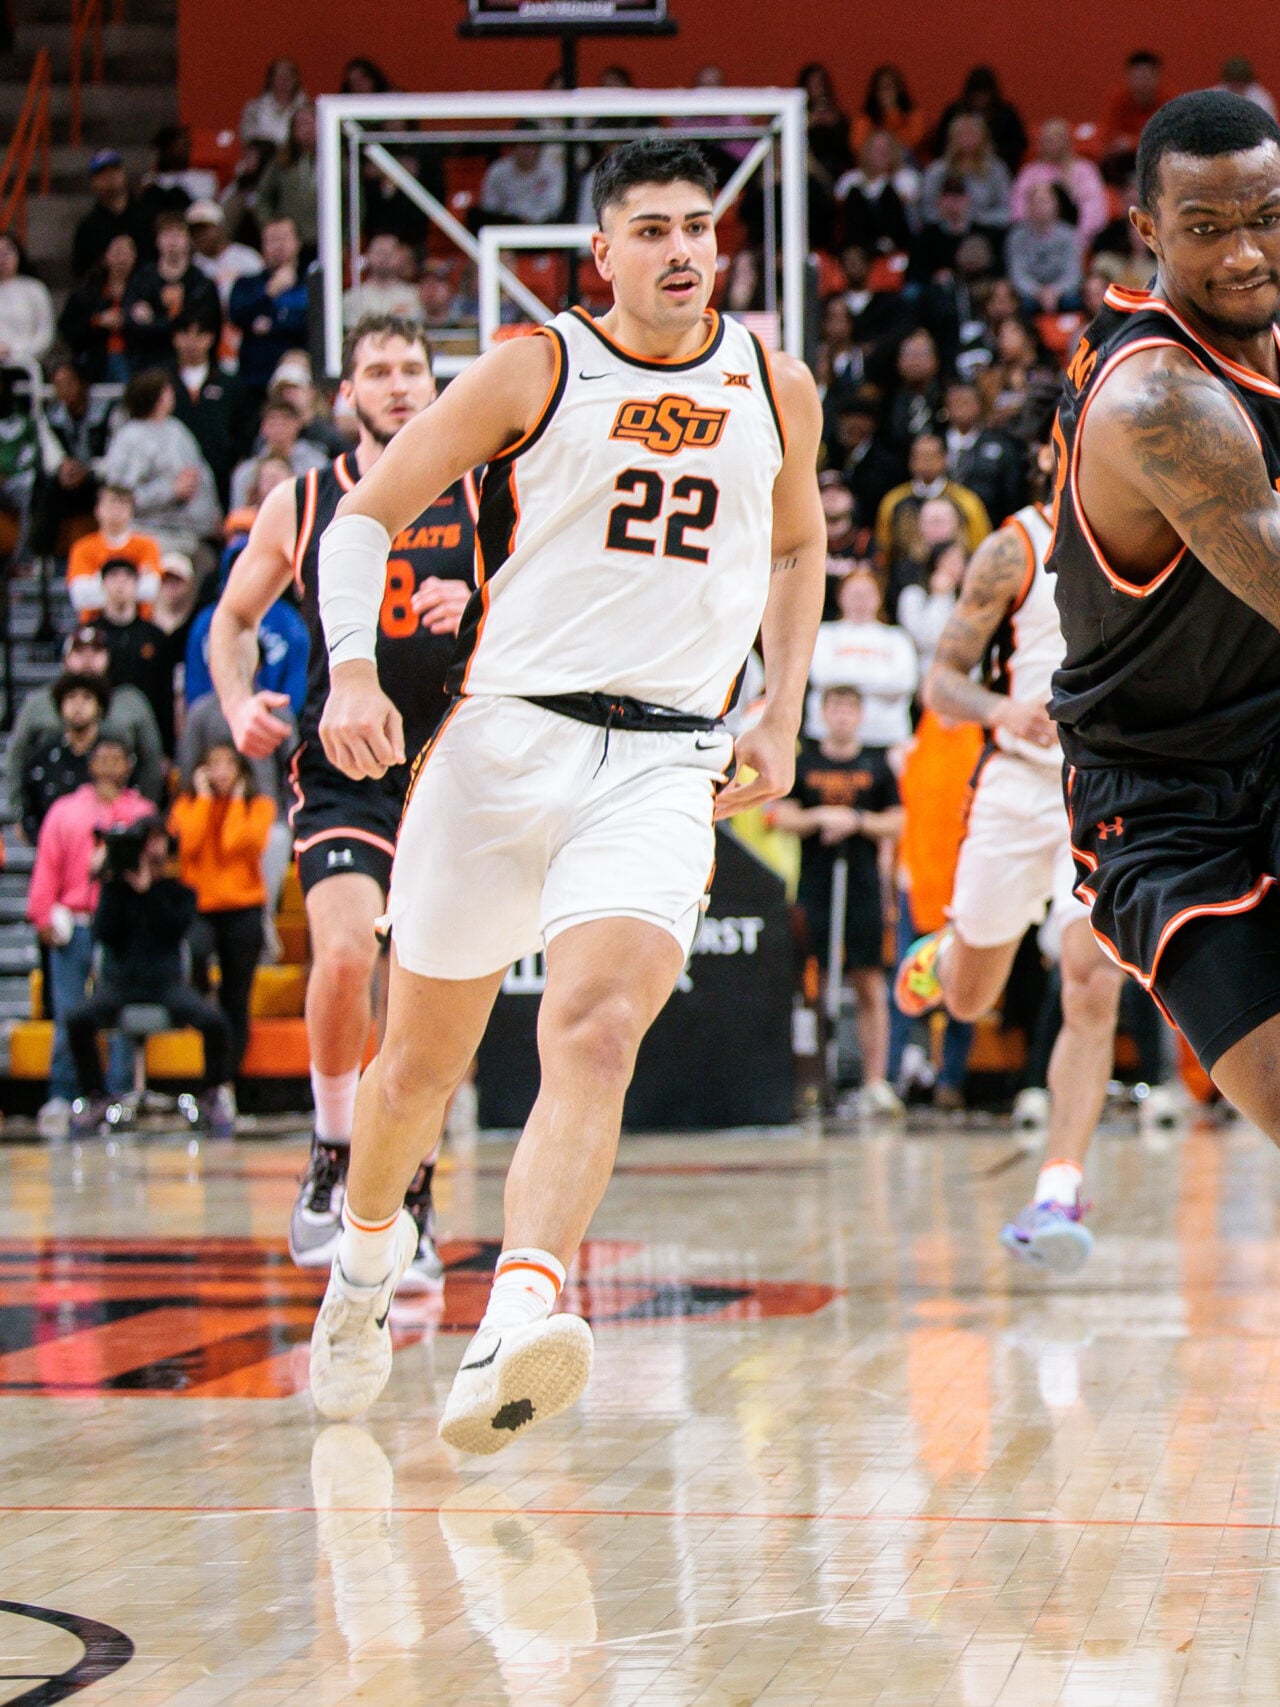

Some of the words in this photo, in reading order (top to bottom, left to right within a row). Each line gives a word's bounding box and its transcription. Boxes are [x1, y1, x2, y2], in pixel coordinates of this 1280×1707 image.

[607, 392, 731, 457] OSU
[390, 523, 462, 551] KATS
[604, 467, 720, 565] 22
[379, 558, 420, 639] 8
[692, 916, 765, 955] RST
